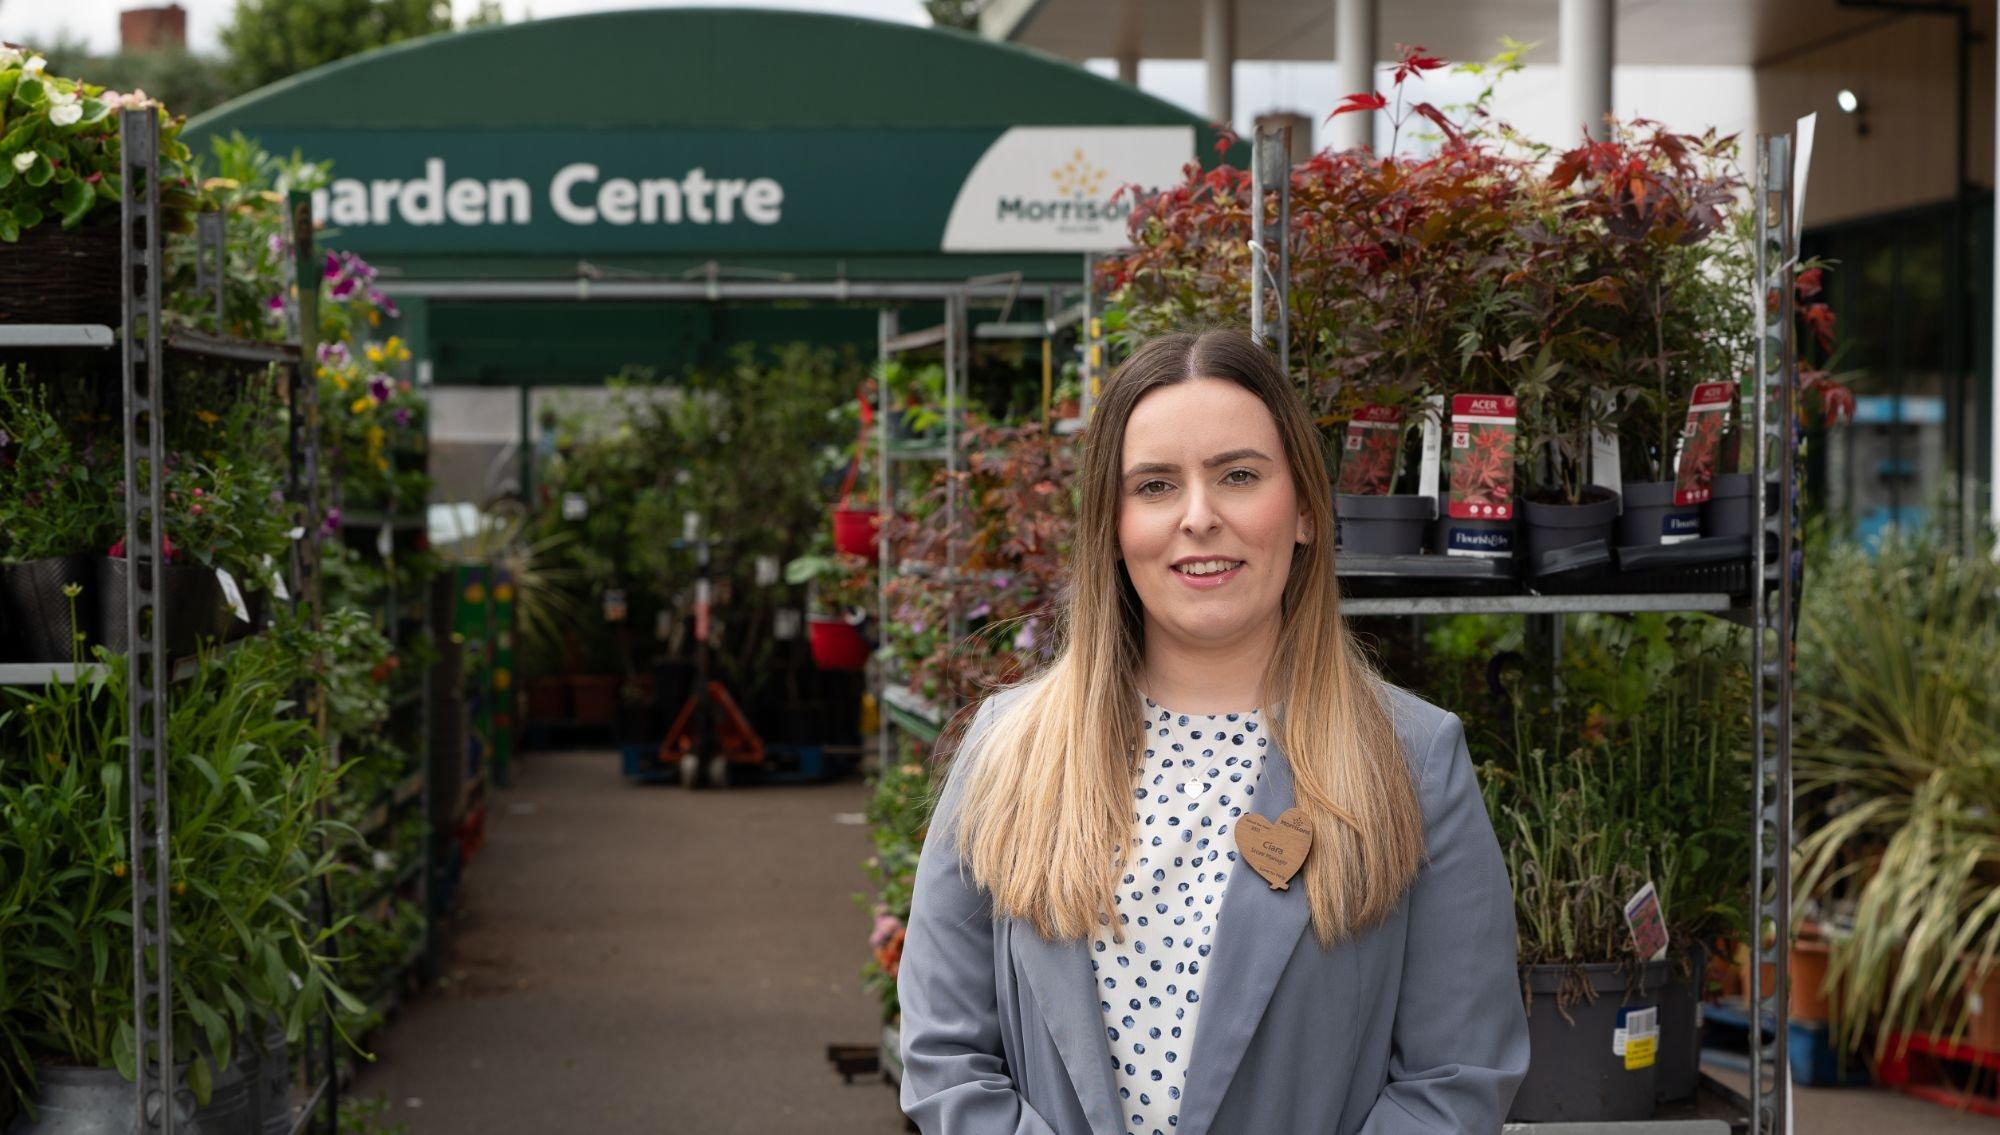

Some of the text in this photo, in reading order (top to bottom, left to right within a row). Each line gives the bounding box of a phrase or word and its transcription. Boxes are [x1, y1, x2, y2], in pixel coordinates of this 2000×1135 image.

[549, 162, 785, 226] Centre
[1471, 399, 1498, 410] ACER
[1281, 820, 1311, 835] Morrisons
[1263, 841, 1284, 854] Ciara
